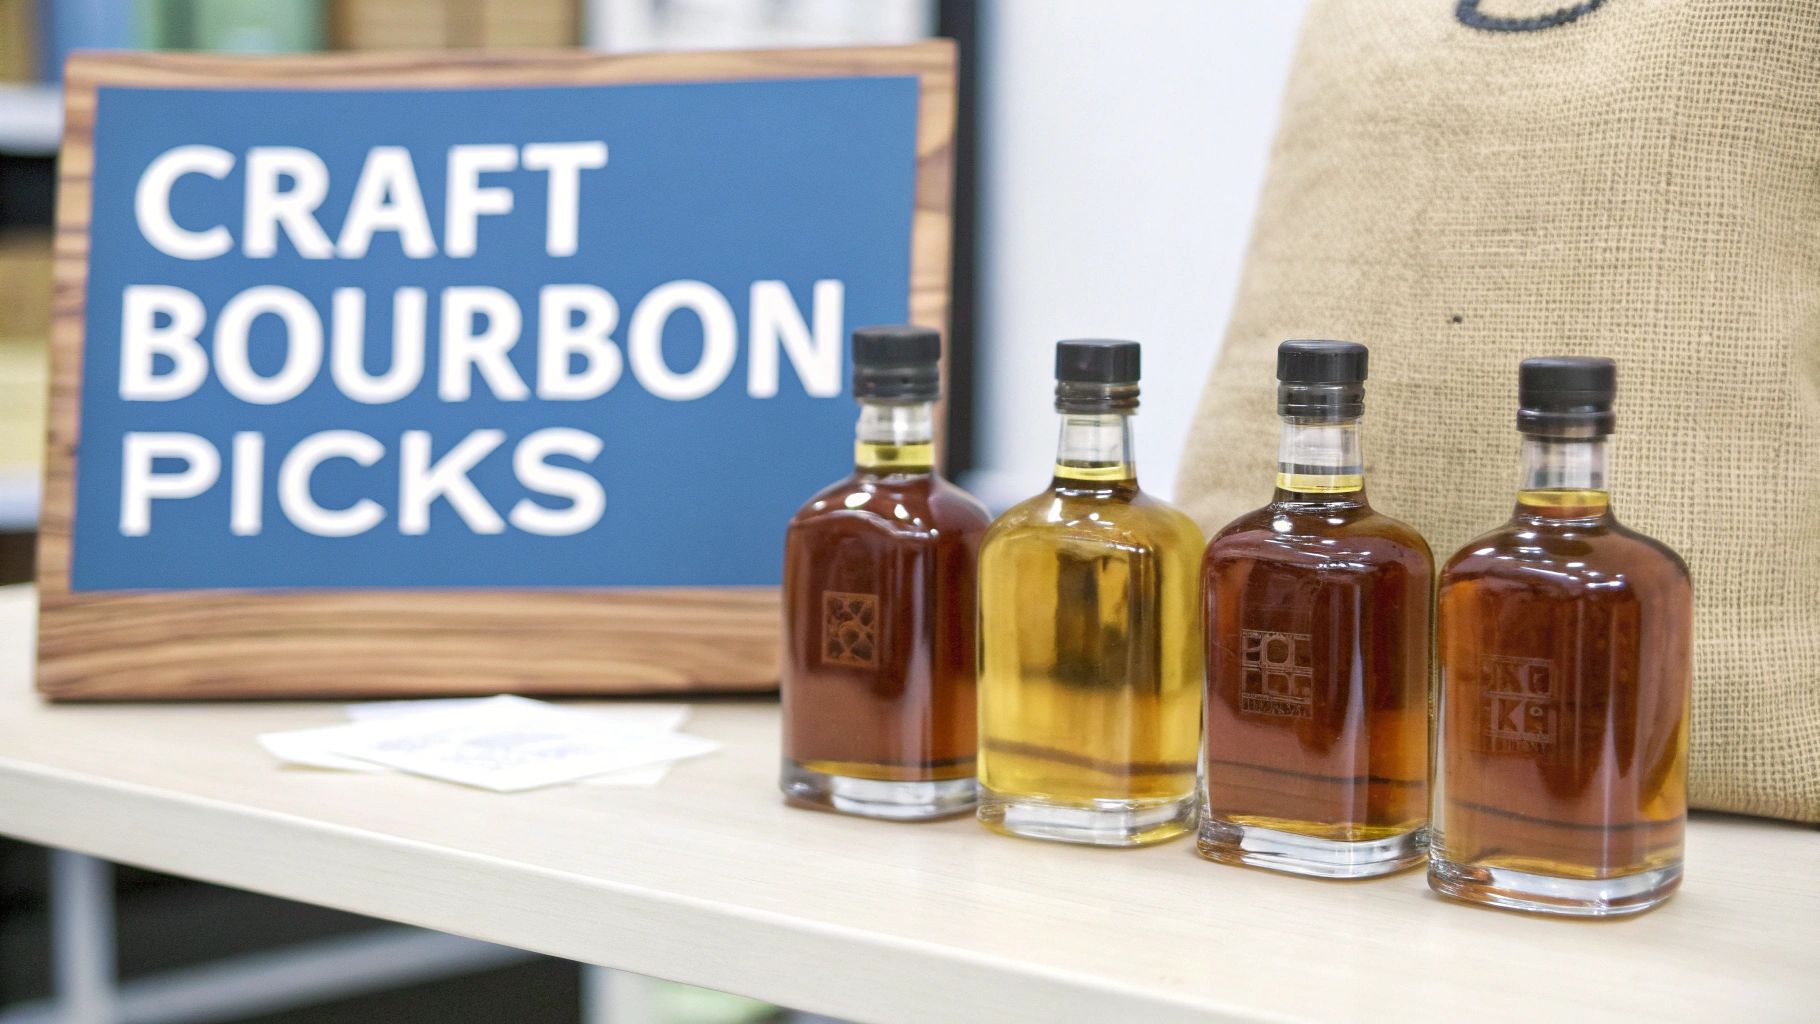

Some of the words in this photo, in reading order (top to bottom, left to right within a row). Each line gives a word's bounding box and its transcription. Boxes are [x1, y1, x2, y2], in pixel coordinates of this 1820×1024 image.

[135, 141, 609, 260] CRAFT
[119, 279, 844, 405] BOURBON
[120, 427, 606, 537] PICKS
